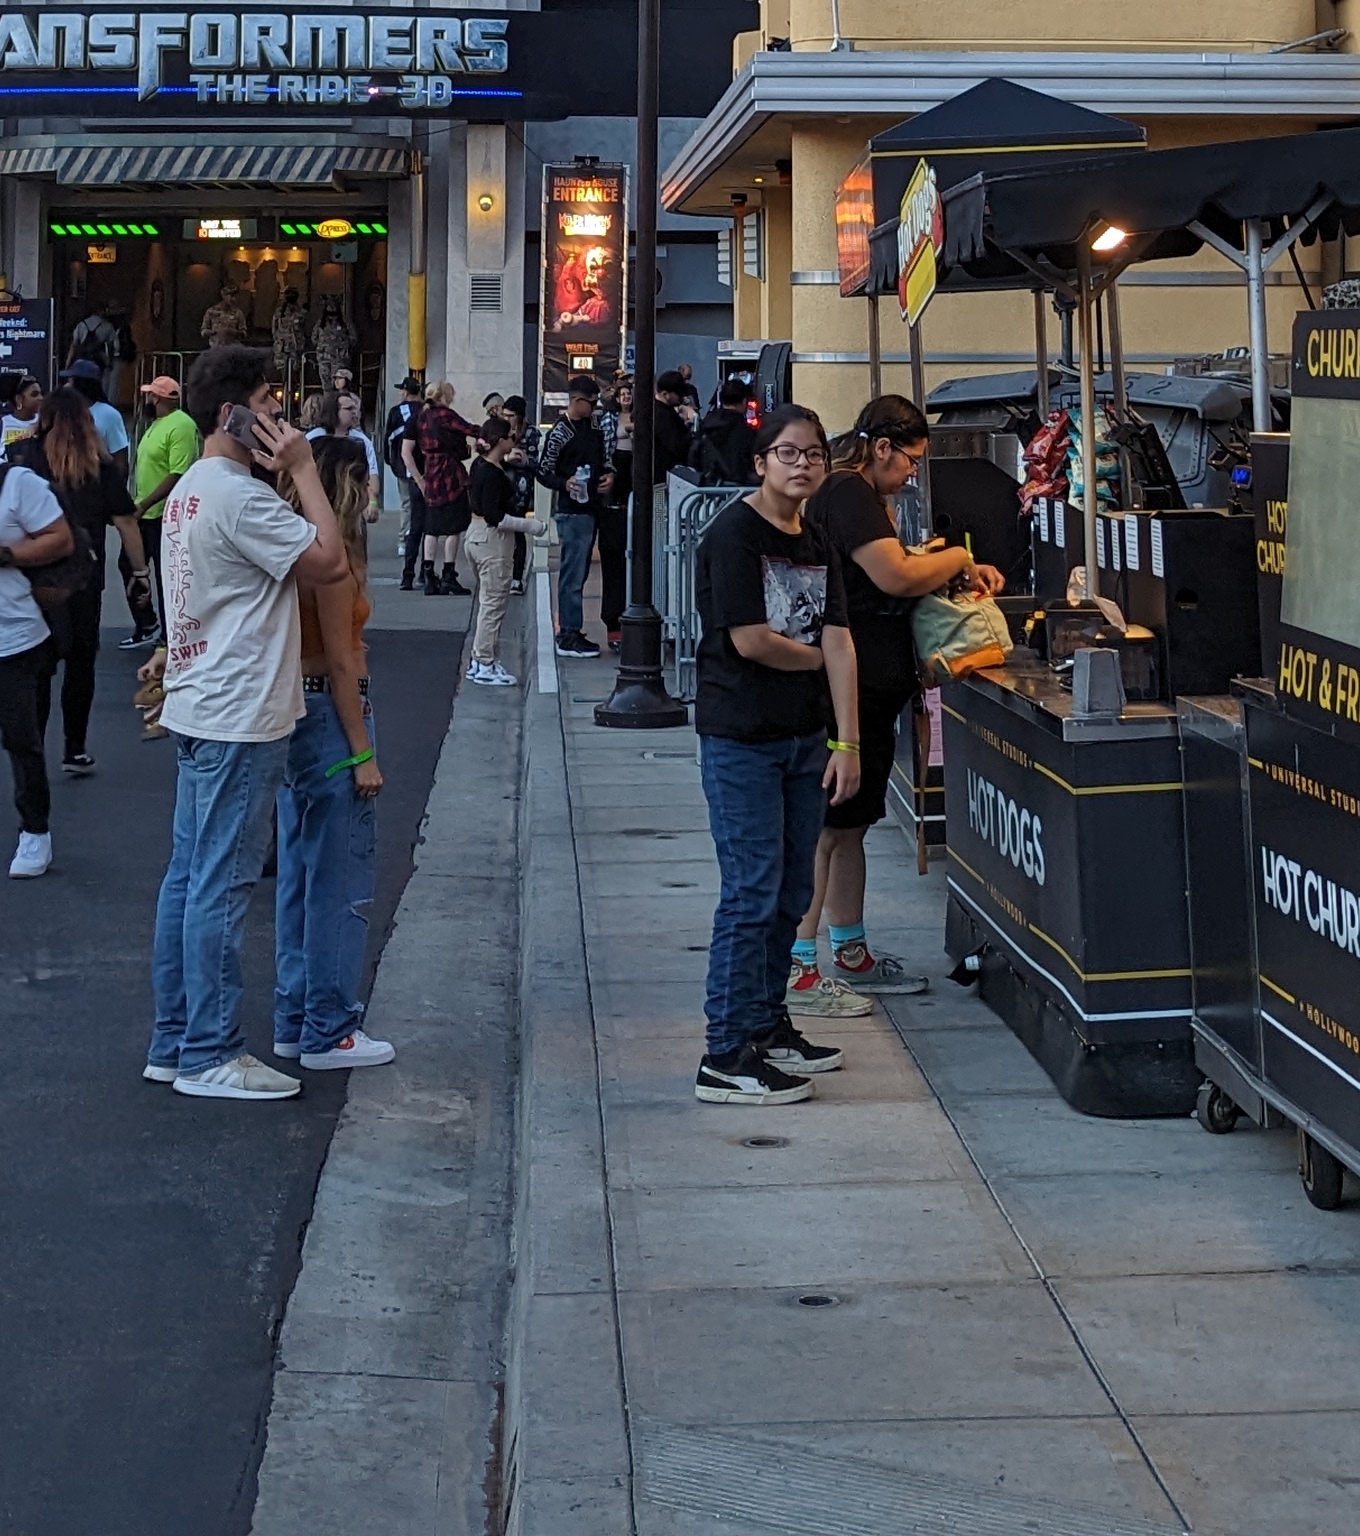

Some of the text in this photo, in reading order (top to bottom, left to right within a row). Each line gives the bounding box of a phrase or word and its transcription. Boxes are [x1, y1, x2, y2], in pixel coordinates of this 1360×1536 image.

[189, 72, 272, 105] THE
[553, 187, 619, 203] ENTRANCE
[554, 176, 591, 188] HAUNTED
[6, 329, 46, 341] Nightmare
[1279, 642, 1316, 699] HOT
[1319, 659, 1332, 713] &
[1271, 763, 1327, 802] UNIVERSAL
[966, 767, 1045, 887] HOT DOGS
[1261, 845, 1301, 922] HOT
